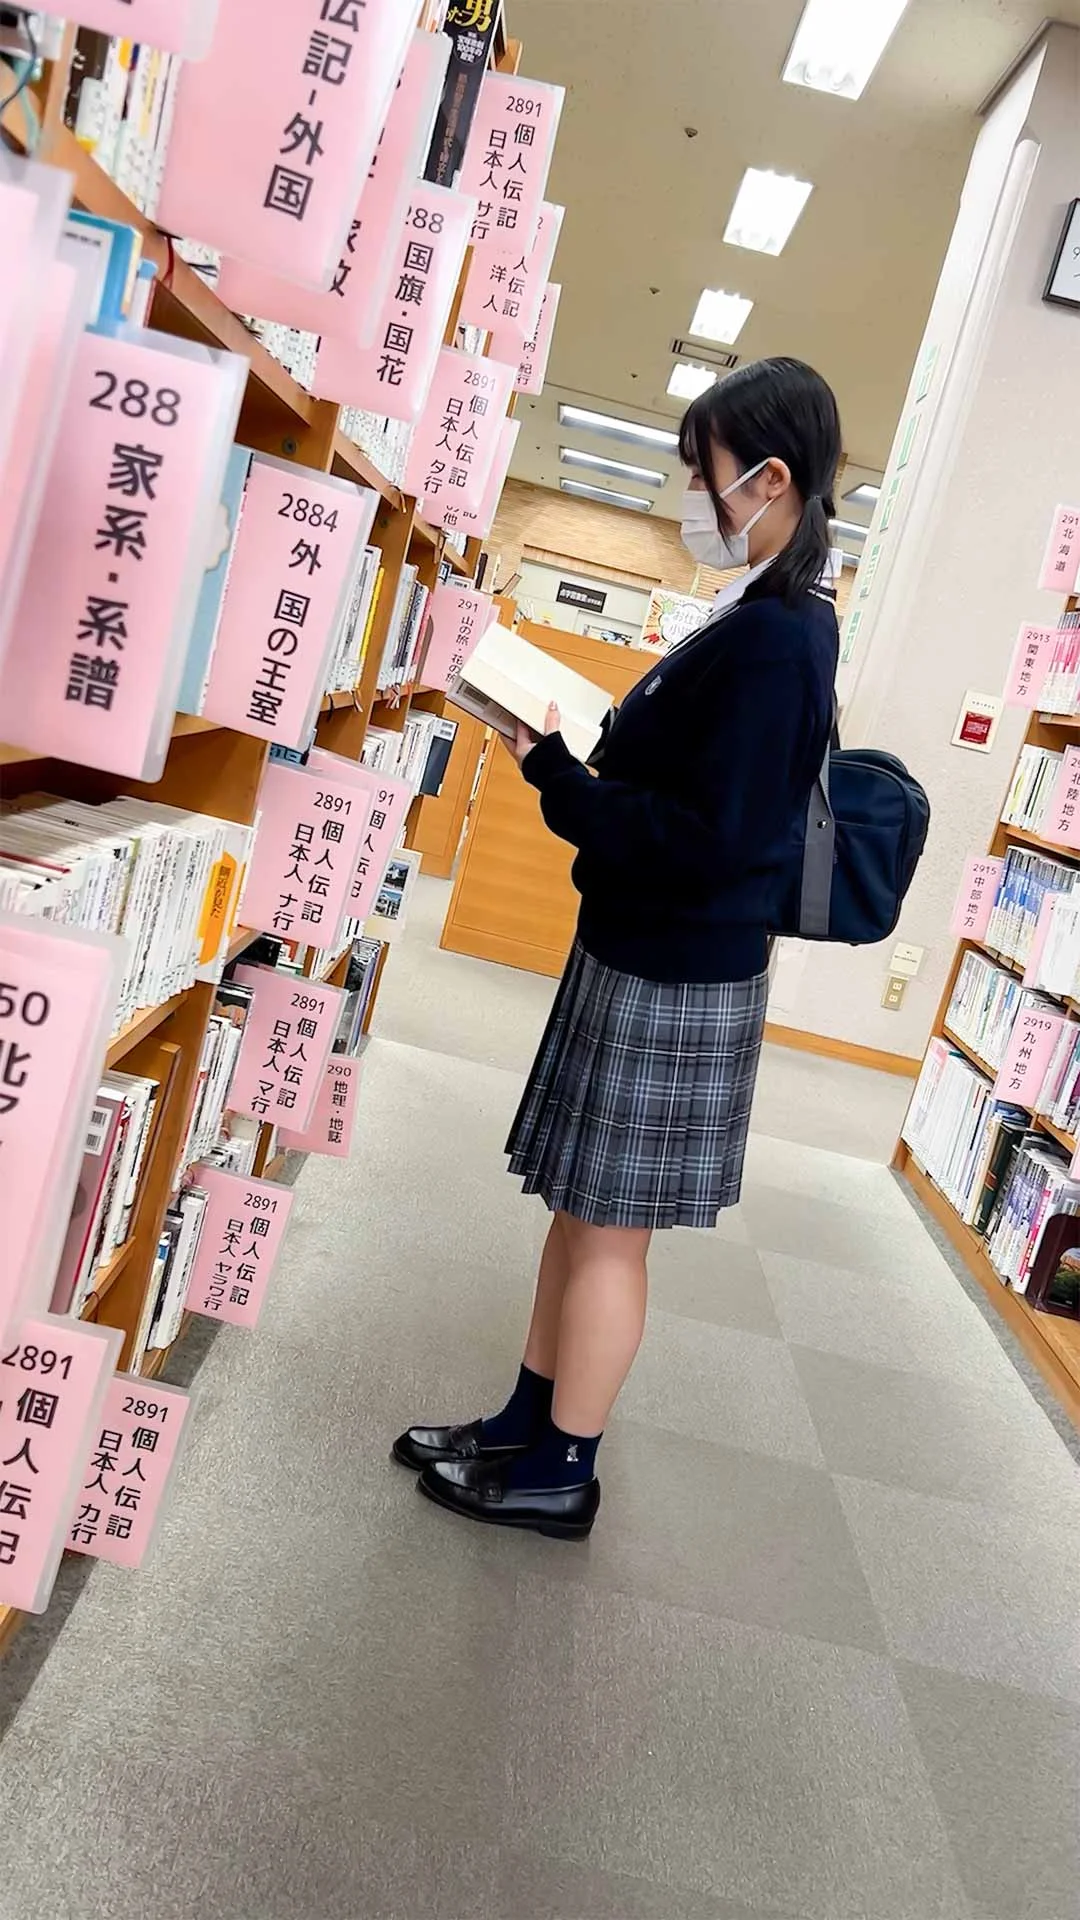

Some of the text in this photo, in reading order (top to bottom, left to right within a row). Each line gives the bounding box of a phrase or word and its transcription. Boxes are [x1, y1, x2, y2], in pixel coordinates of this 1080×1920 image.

[506, 96, 542, 118] 2891
[470, 129, 507, 240] 日本人 サ行
[497, 123, 535, 229] 個人伝記
[405, 206, 444, 234] 88
[482, 250, 512, 313] 洋人
[376, 240, 434, 386] 国旗・国花
[88, 370, 181, 427] 288
[464, 370, 496, 391] 2891
[424, 397, 463, 494] 日本人 タ行
[449, 394, 488, 488] 個人伝記
[277, 492, 339, 533] 2884
[64, 442, 164, 711] 家系・系譜
[1055, 528, 1073, 572] 北海道
[457, 599, 479, 613] 291
[1026, 631, 1050, 643] 2913
[1016, 643, 1039, 696] 関東地方
[313, 792, 352, 815] 2891
[272, 823, 314, 931] 日本人 ナ行
[301, 819, 345, 924] 個人伝記
[972, 863, 997, 876] 2915
[964, 876, 985, 928] 中部地方
[290, 993, 325, 1014] 2891
[1024, 1015, 1052, 1031] 2919
[250, 1019, 291, 1114] 日本人 マ行
[277, 1017, 318, 1109] 個人伝記
[327, 1064, 351, 1077] 290
[1009, 1031, 1036, 1091] 九州地方
[328, 1080, 348, 1144] 地理・地誌
[244, 1193, 278, 1214] 2891
[203, 1218, 244, 1311] 日本人 ヤラワ行
[229, 1216, 270, 1306] 個人伝記
[122, 1397, 169, 1423] 2891
[71, 1430, 123, 1545] 日本人 カ行
[105, 1426, 159, 1539] 個人伝記
